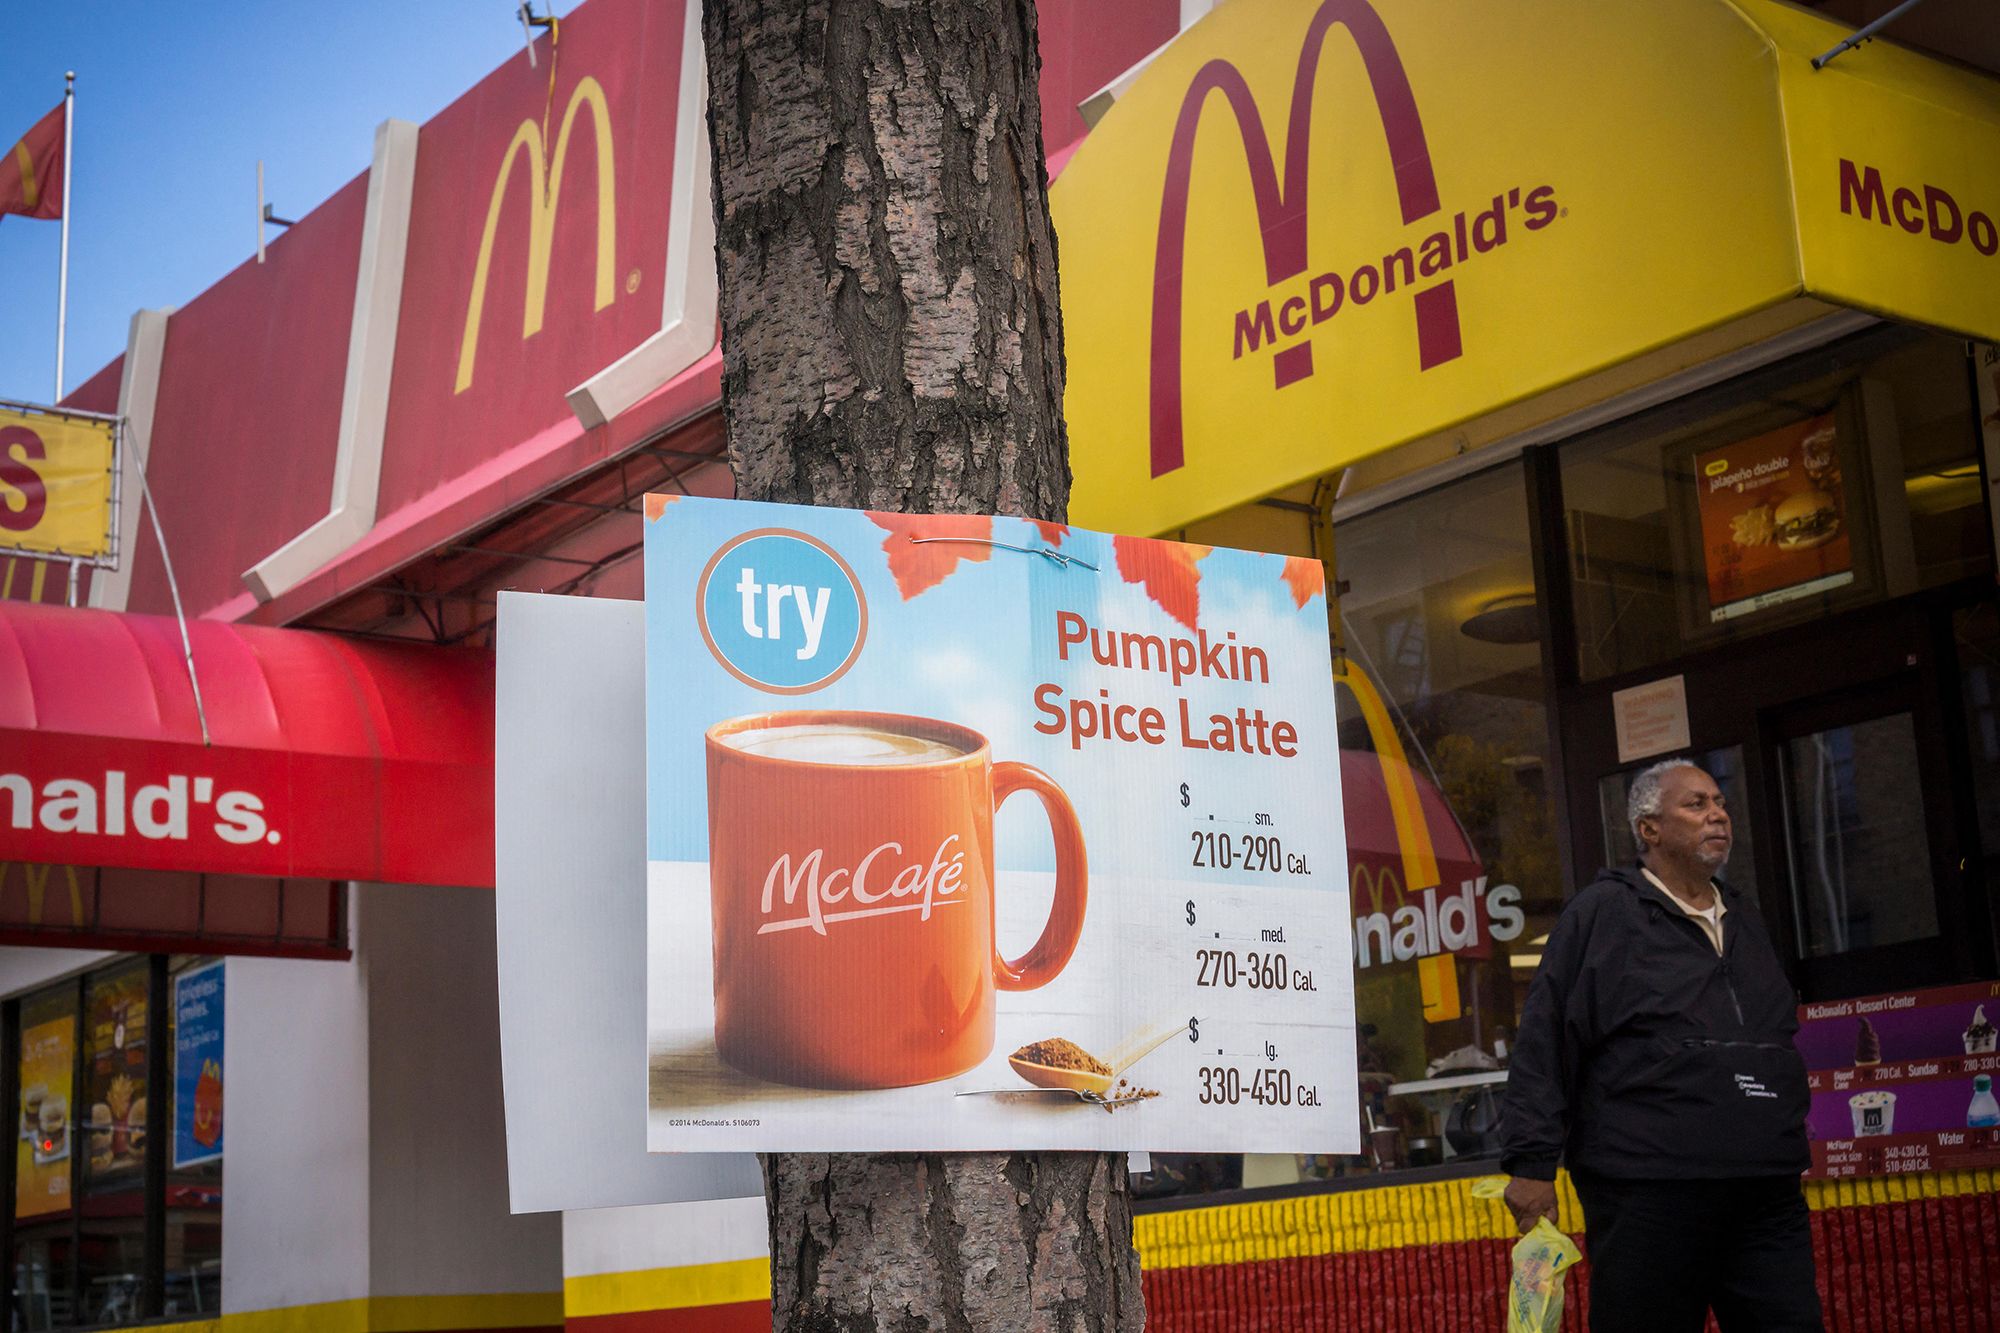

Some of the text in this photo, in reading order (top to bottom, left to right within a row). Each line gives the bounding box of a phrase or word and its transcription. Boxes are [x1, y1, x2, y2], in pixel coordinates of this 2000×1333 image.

[1839, 157, 2000, 257] McDo
[1232, 185, 1558, 361] McDonald's
[1753, 456, 1790, 477] double
[736, 567, 832, 660] try
[1056, 610, 1269, 687] Pumpkin
[1033, 683, 1298, 758] Spice Latte
[1254, 812, 1274, 827] sm.
[1191, 831, 1312, 875] 210-290 Cal.
[759, 834, 965, 936] McCafé
[1261, 926, 1287, 943] med.
[1196, 949, 1317, 991] 270-360 Cal.
[1807, 995, 1916, 1020] McDonald's Dessert Center
[1265, 1040, 1279, 1061] lg.
[1875, 1066, 1903, 1081] 270 Cal.
[1908, 1063, 1939, 1077] Sundae
[1199, 1066, 1322, 1107] 330-450 Cal.
[732, 1119, 761, 1127] S106073
[1937, 1132, 1965, 1146] Water
[1826, 1150, 1862, 1164] snack size
[1915, 1144, 1930, 1158] Cal.
[1826, 1164, 1856, 1179] reg. size
[1916, 1158, 1931, 1171] Cal.
